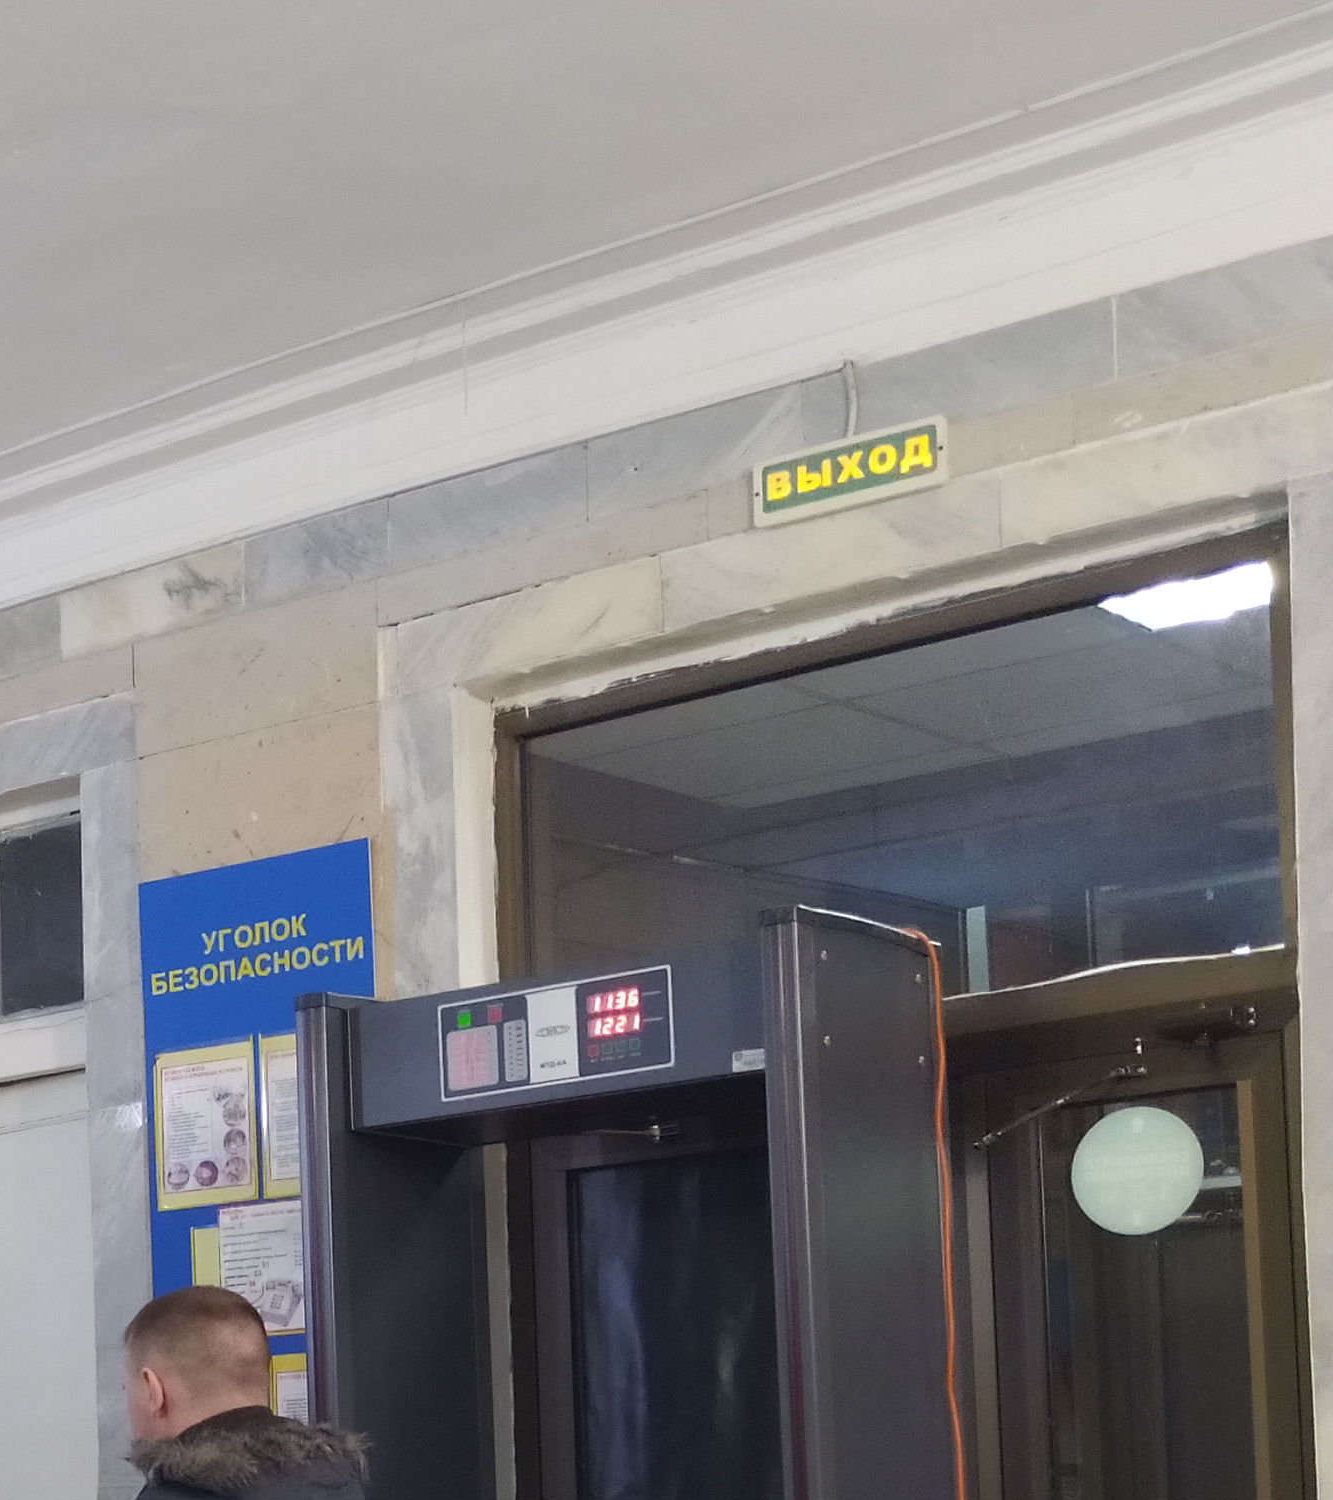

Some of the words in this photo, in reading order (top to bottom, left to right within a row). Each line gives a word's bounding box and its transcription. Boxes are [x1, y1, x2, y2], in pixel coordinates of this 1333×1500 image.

[765, 432, 933, 503] ВЫХОД
[201, 913, 307, 955] УГОЛОК
[150, 936, 365, 996] БЕЗОПАСНОСТИ
[593, 988, 639, 1012] 1136
[593, 1012, 641, 1036] 1221
